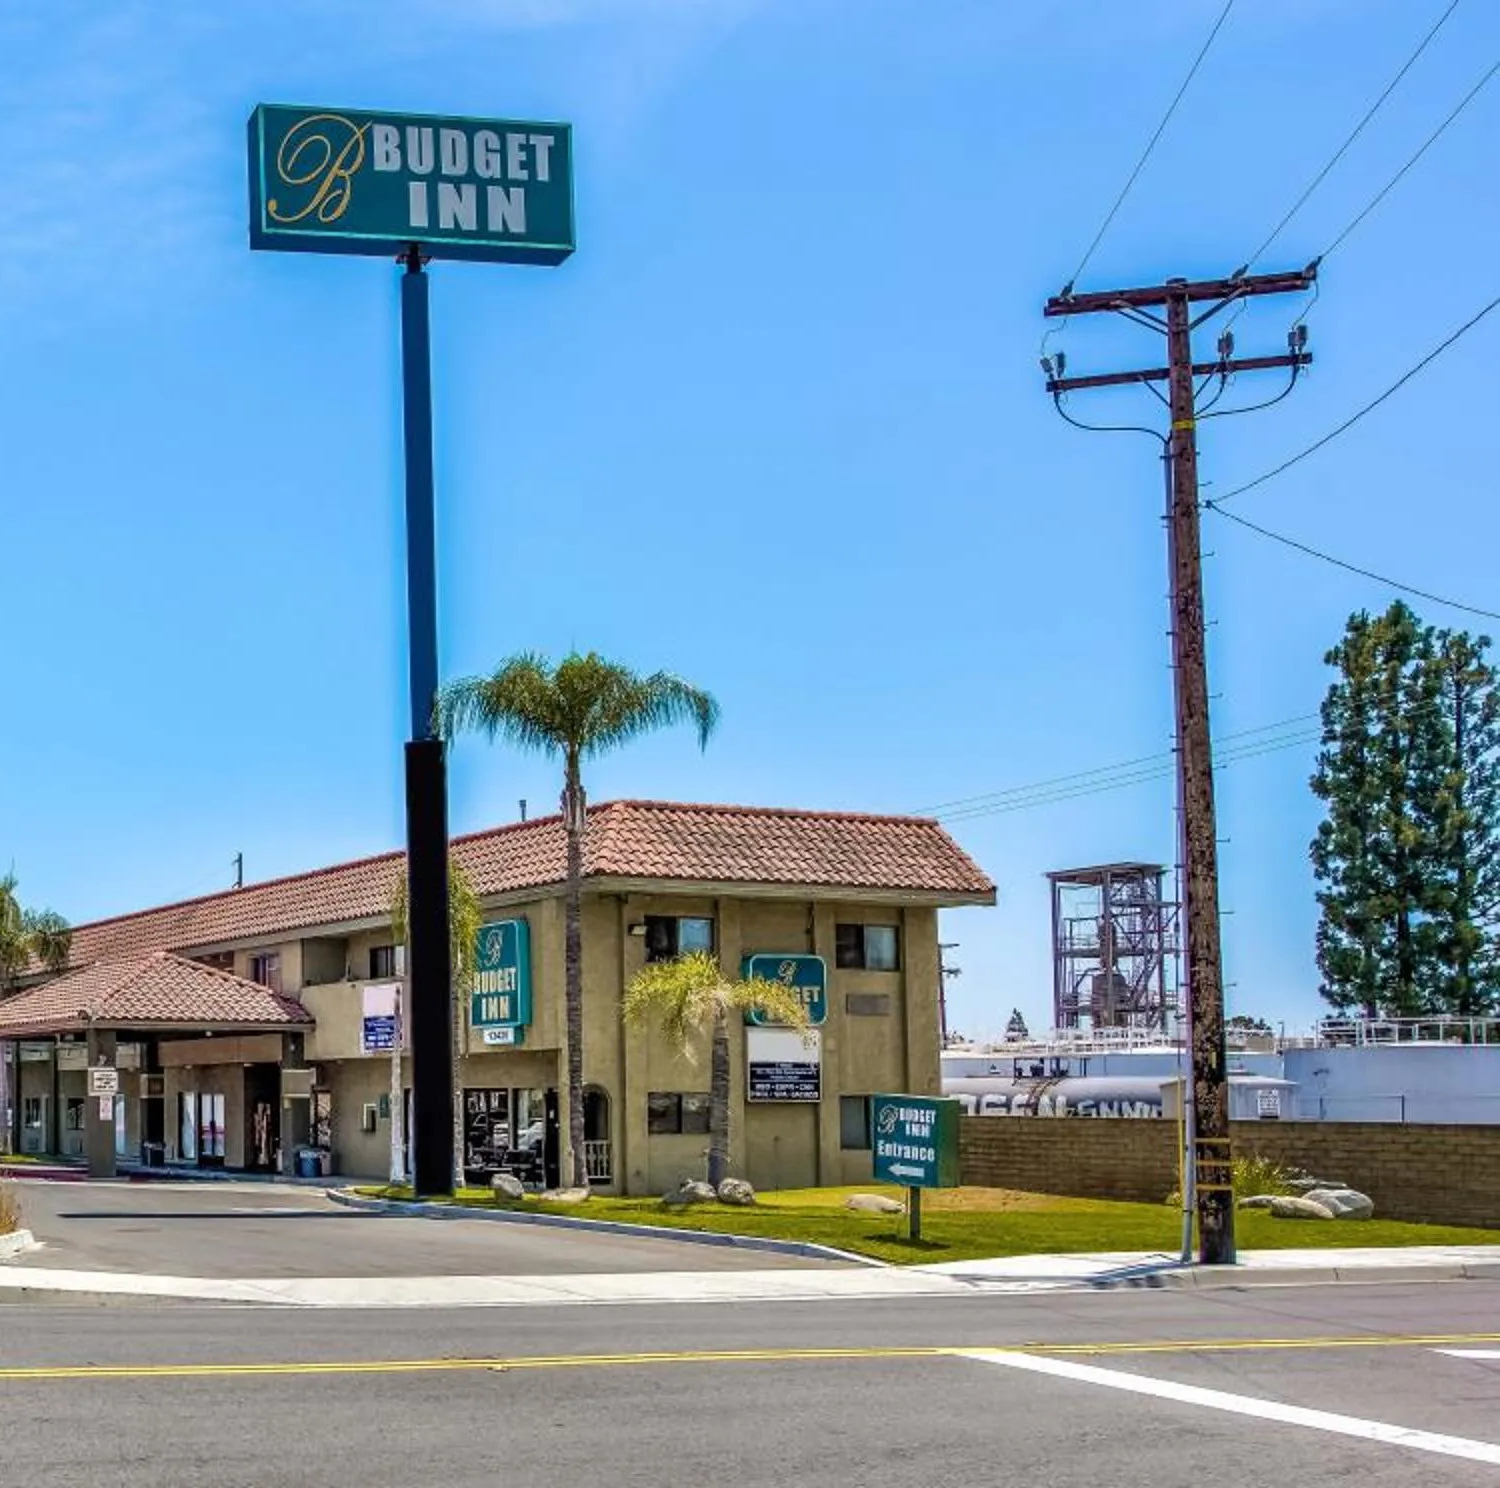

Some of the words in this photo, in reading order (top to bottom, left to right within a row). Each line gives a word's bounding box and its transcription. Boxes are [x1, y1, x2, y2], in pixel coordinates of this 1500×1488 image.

[372, 123, 555, 182] BUDGET
[407, 181, 528, 234] INN
[473, 967, 516, 995] BUDGET
[481, 995, 510, 1021] INN
[899, 1107, 936, 1125] BUDGET
[905, 1122, 932, 1138] INN
[877, 1140, 935, 1163] Entrance
